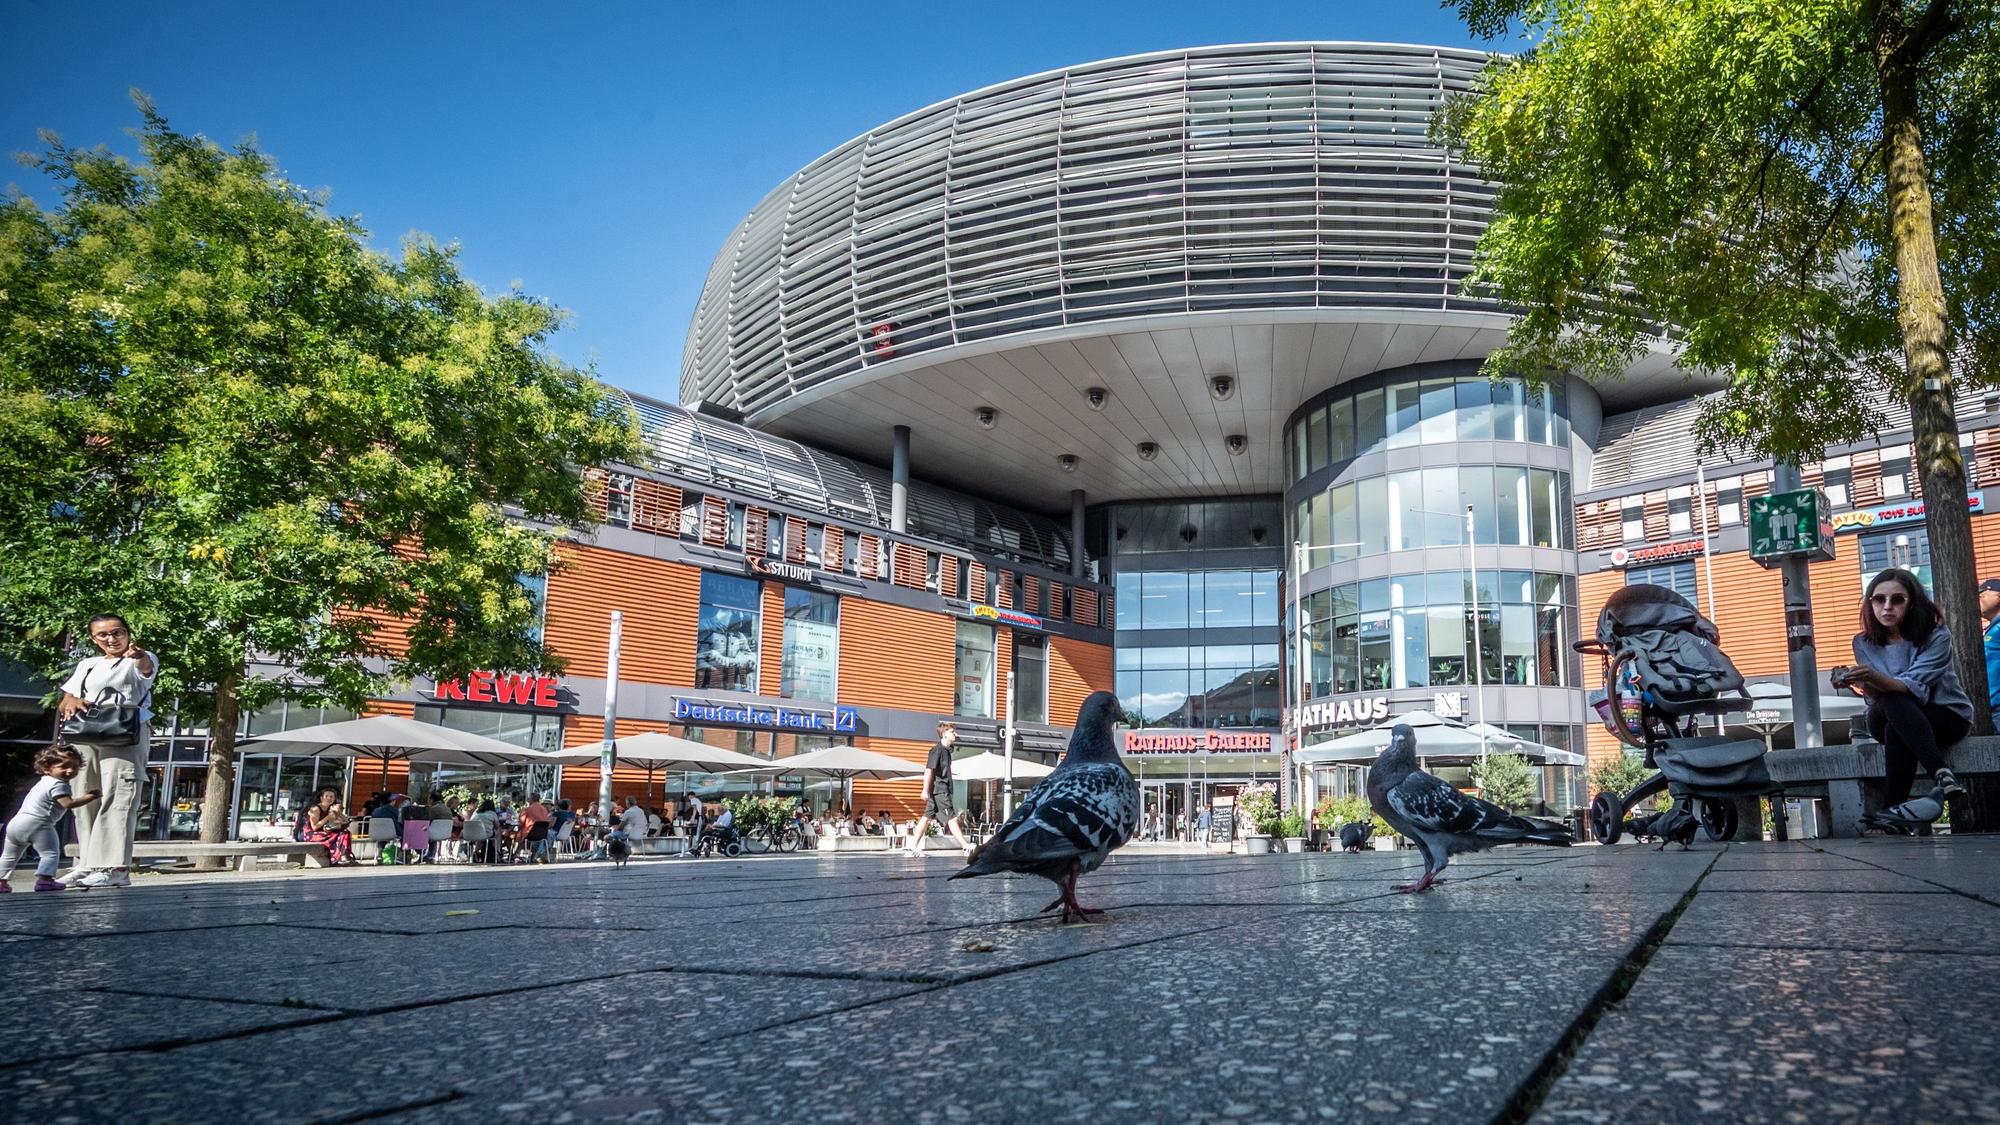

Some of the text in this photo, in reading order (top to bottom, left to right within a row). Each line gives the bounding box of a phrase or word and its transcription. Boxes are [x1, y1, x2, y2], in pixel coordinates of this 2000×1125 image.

[1832, 511, 1874, 529] MYTHS
[1878, 507, 1905, 521] TOYS
[1634, 540, 1704, 560] vodafone
[770, 561, 812, 582] SATURN
[434, 671, 558, 708] REWE
[675, 699, 826, 730] Deutsche Bank
